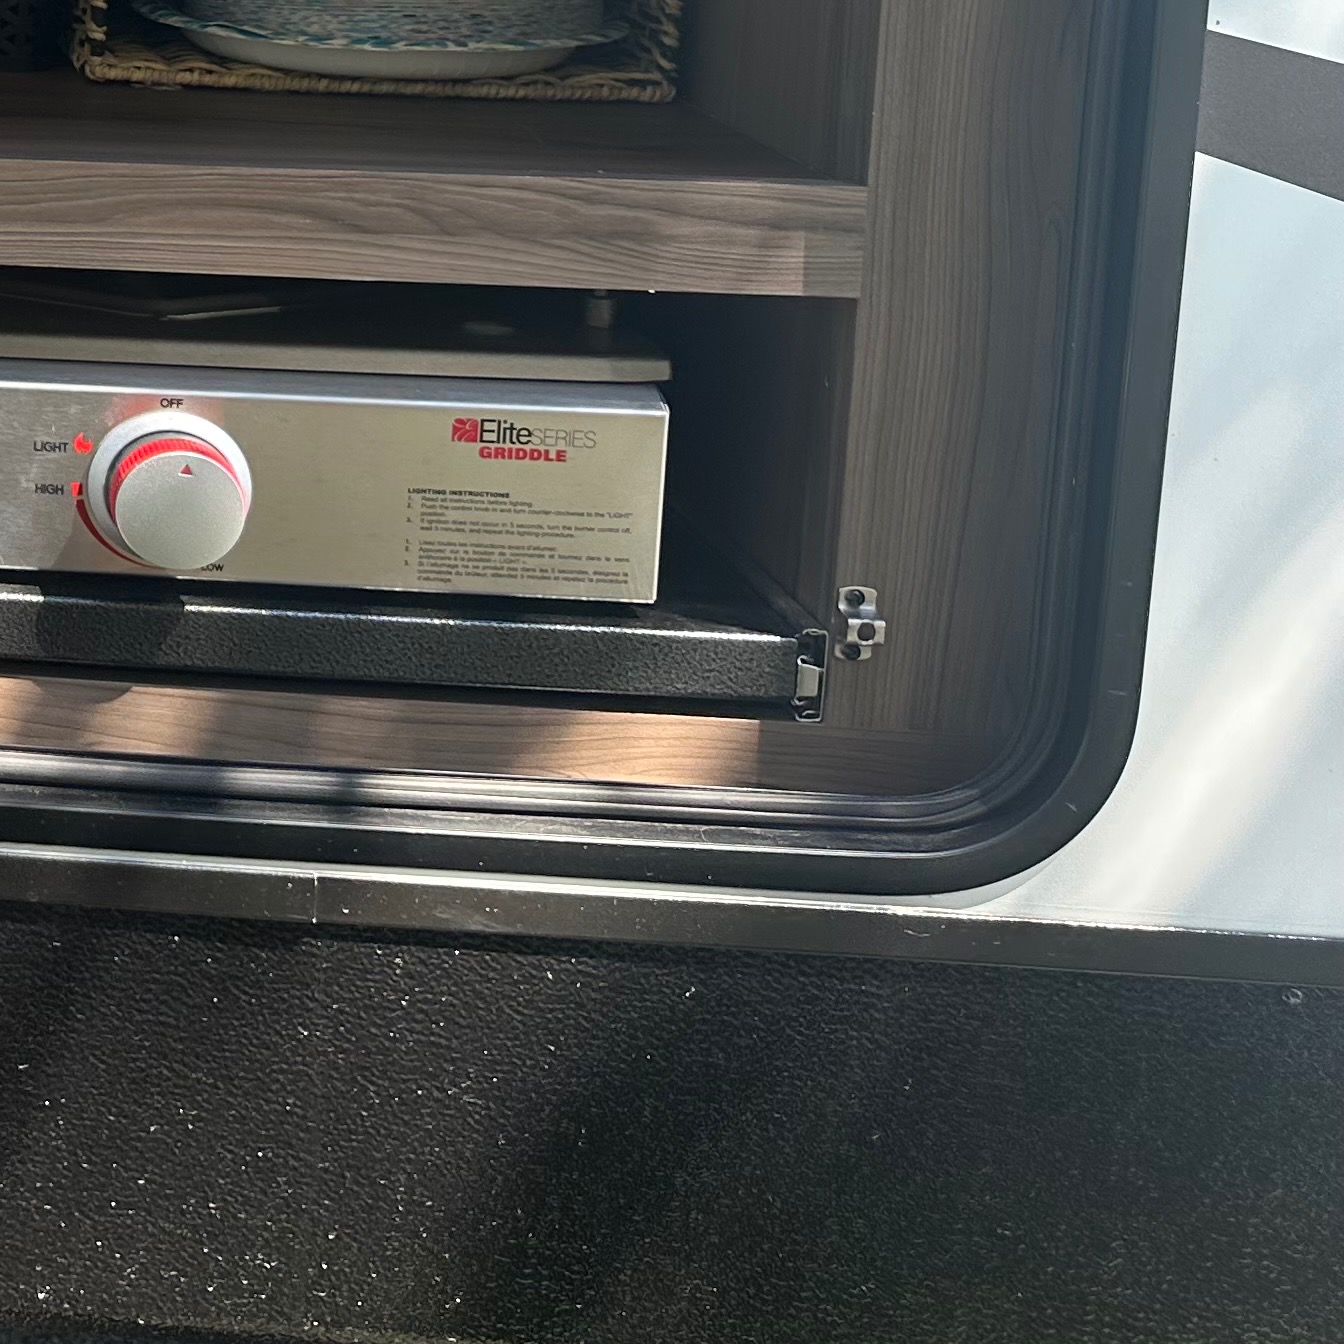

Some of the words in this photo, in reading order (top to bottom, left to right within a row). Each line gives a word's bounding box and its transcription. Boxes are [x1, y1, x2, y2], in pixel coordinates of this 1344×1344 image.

[160, 398, 184, 408] OFF
[33, 441, 69, 453] LIGHT
[479, 446, 567, 462] GRIDDLE
[35, 484, 64, 495] HIGH
